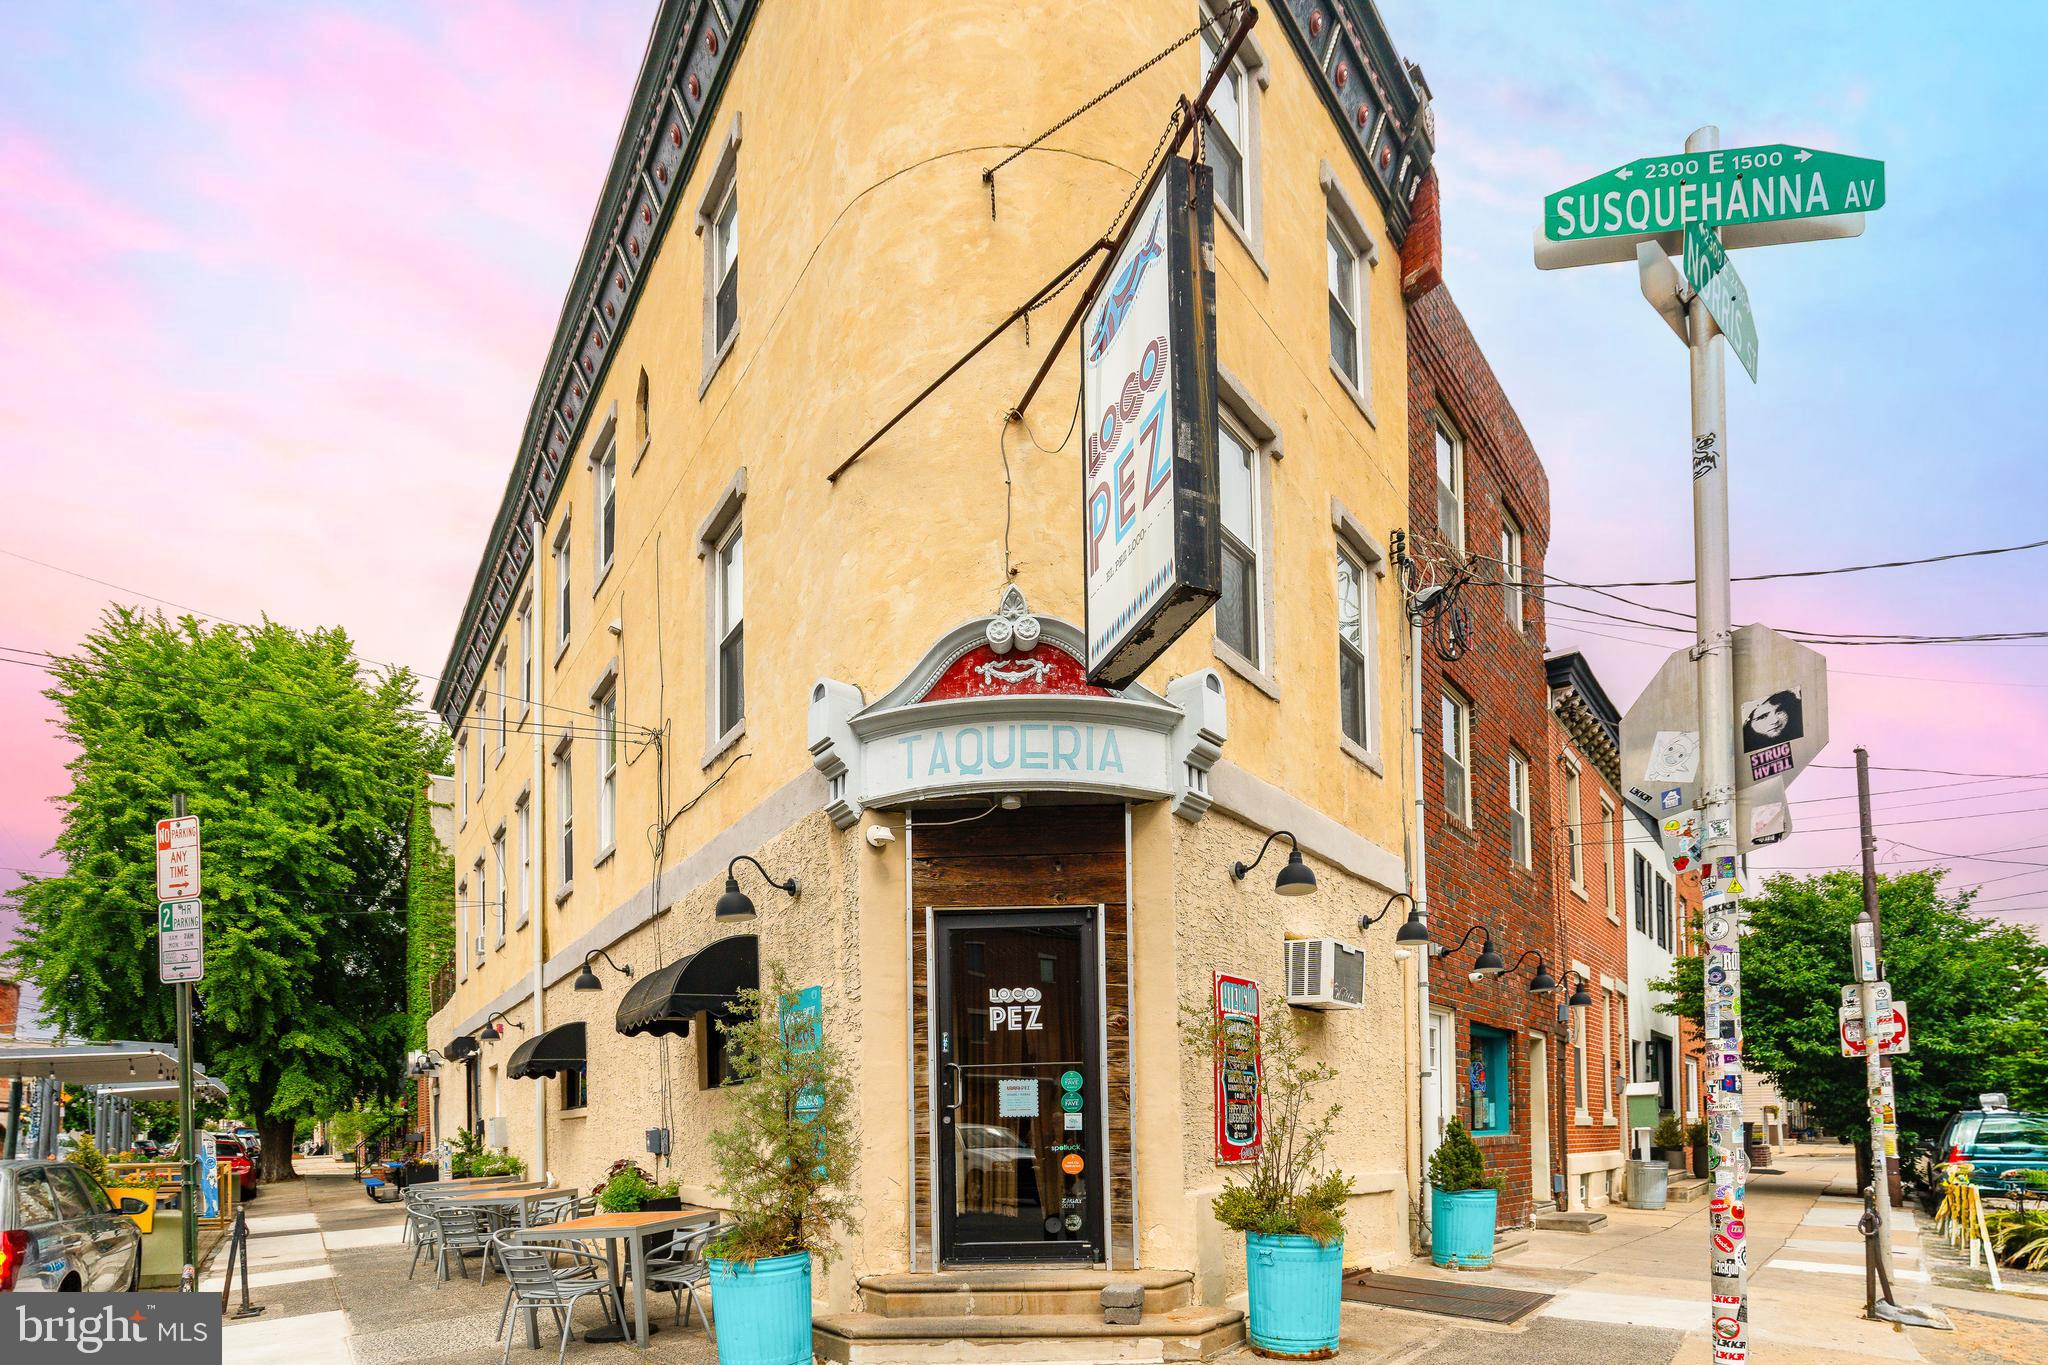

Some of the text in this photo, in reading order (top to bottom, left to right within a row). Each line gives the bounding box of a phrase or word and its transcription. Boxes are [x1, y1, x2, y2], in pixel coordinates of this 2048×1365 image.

[1645, 151, 1783, 179] 2300 E 1500
[1556, 171, 1875, 236] SUSQUEHANNA AV
[1687, 231, 1757, 372] NORRIS ST
[1089, 336, 1168, 479] LOCO
[1089, 389, 1171, 578] PEZ
[1128, 528, 1146, 556] LOCO
[898, 723, 1124, 779] TAQUERIA
[1751, 743, 1790, 767] STRUG
[160, 826, 195, 844] NO PARKING
[171, 850, 187, 863] ANY
[170, 865, 189, 878] TIME
[163, 904, 192, 928] 2 HR
[174, 916, 199, 928] PARKING
[989, 987, 1042, 1003] LOCO
[989, 1005, 1043, 1031] PEZ
[1051, 1144, 1080, 1152] spotluck
